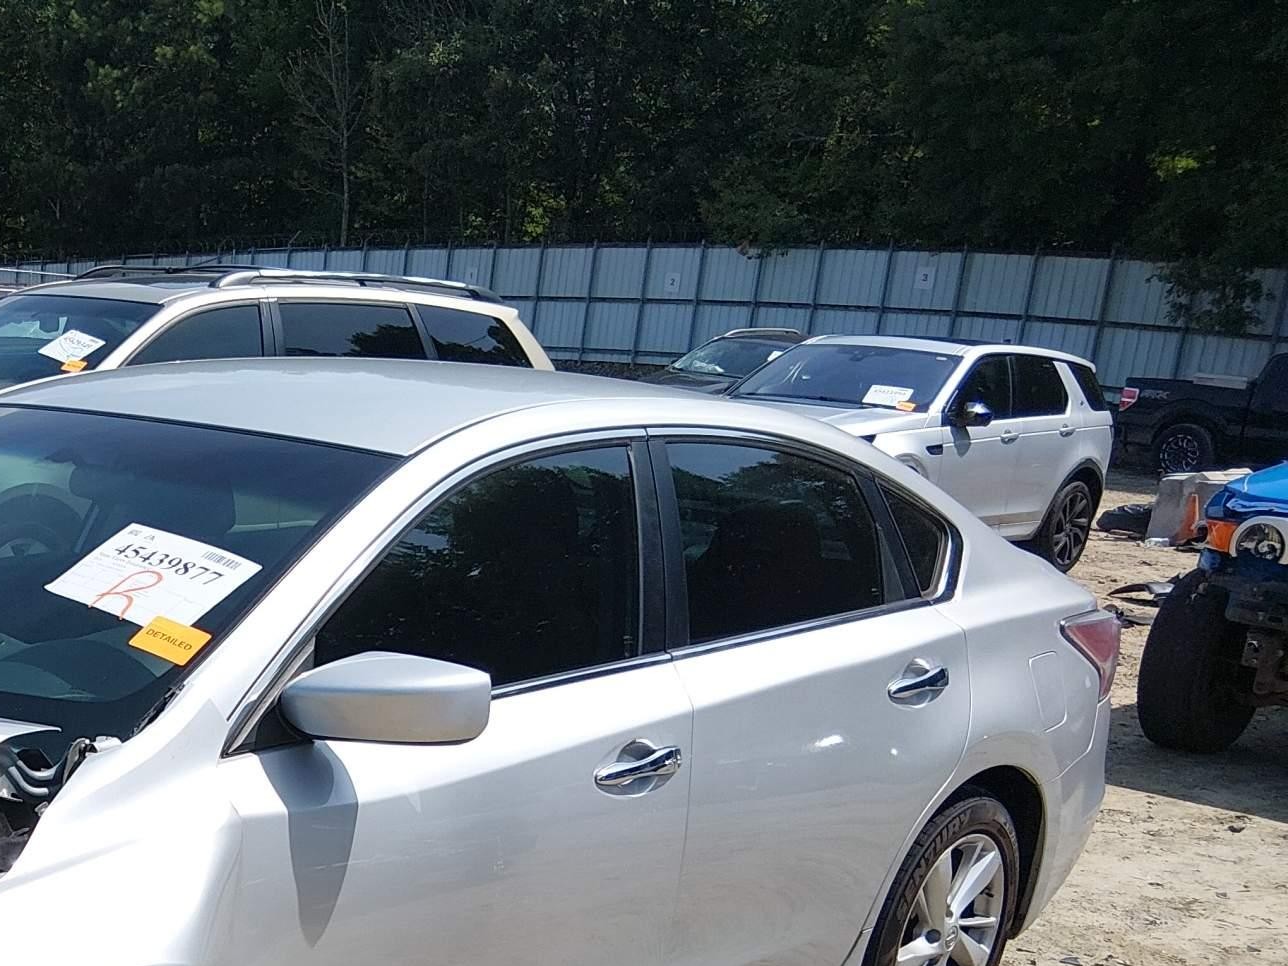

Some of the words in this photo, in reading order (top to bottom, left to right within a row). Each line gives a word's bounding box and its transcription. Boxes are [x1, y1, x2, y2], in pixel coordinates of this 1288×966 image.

[669, 277, 676, 286] 2
[921, 272, 929, 281] 3
[114, 543, 225, 585] 45439877
[87, 570, 164, 620] R
[145, 628, 193, 651] DETAILED
